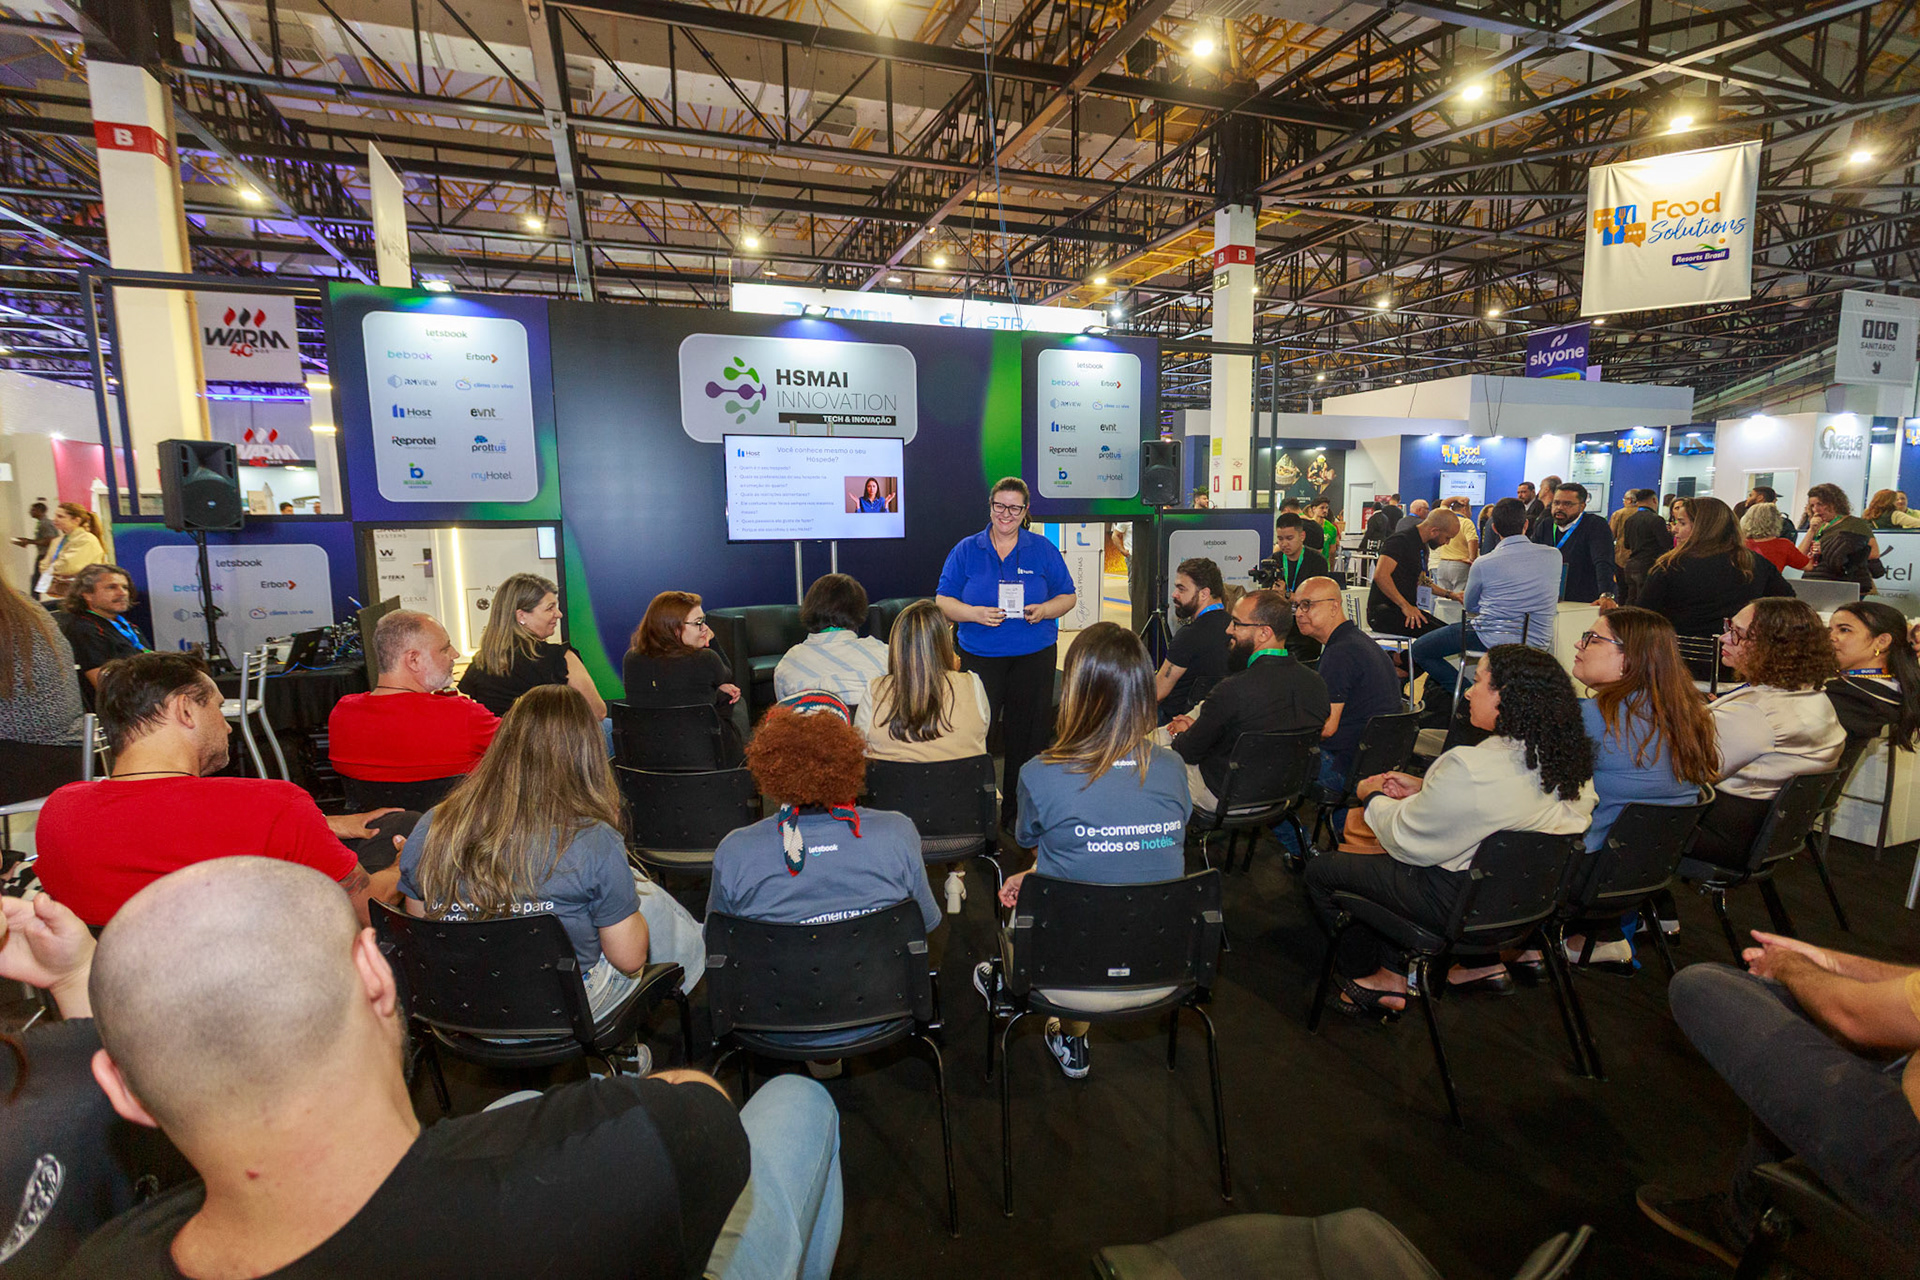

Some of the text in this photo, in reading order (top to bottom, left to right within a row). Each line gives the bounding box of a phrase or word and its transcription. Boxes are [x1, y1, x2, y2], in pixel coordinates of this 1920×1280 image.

[113, 127, 135, 147] B
[156, 138, 166, 157] B
[1651, 192, 1721, 221] Food
[1648, 217, 1748, 244] Solutions
[1238, 249, 1248, 261] B
[1675, 250, 1726, 264] Resorts Brasil
[204, 327, 290, 349] WARM
[425, 329, 468, 338] letsbook
[1860, 341, 1896, 352] SANITÁRIOS
[387, 350, 491, 361] bebook Erbon
[1529, 346, 1585, 367] skyone
[776, 368, 849, 388] HSMAI
[1051, 379, 1080, 387] bebook
[777, 391, 897, 411] INNOVATION
[407, 407, 496, 418] Host evnt
[822, 415, 892, 426] TECH & INOVAÇÃO
[1100, 423, 1117, 431] evnt
[392, 436, 436, 447] Reprotel
[1632, 437, 1653, 446] Food
[1049, 446, 1077, 454] Reprotel
[1459, 445, 1480, 456] Food
[471, 471, 512, 482] myHotel
[1097, 473, 1124, 482] myHotel
[215, 559, 262, 568] letsbook
[261, 581, 288, 589] Erbon
[1074, 820, 1181, 837] O e-commerce para
[808, 844, 838, 854] letsbook
[1087, 835, 1176, 852] todos os hotéis.
[524, 900, 555, 914] para
